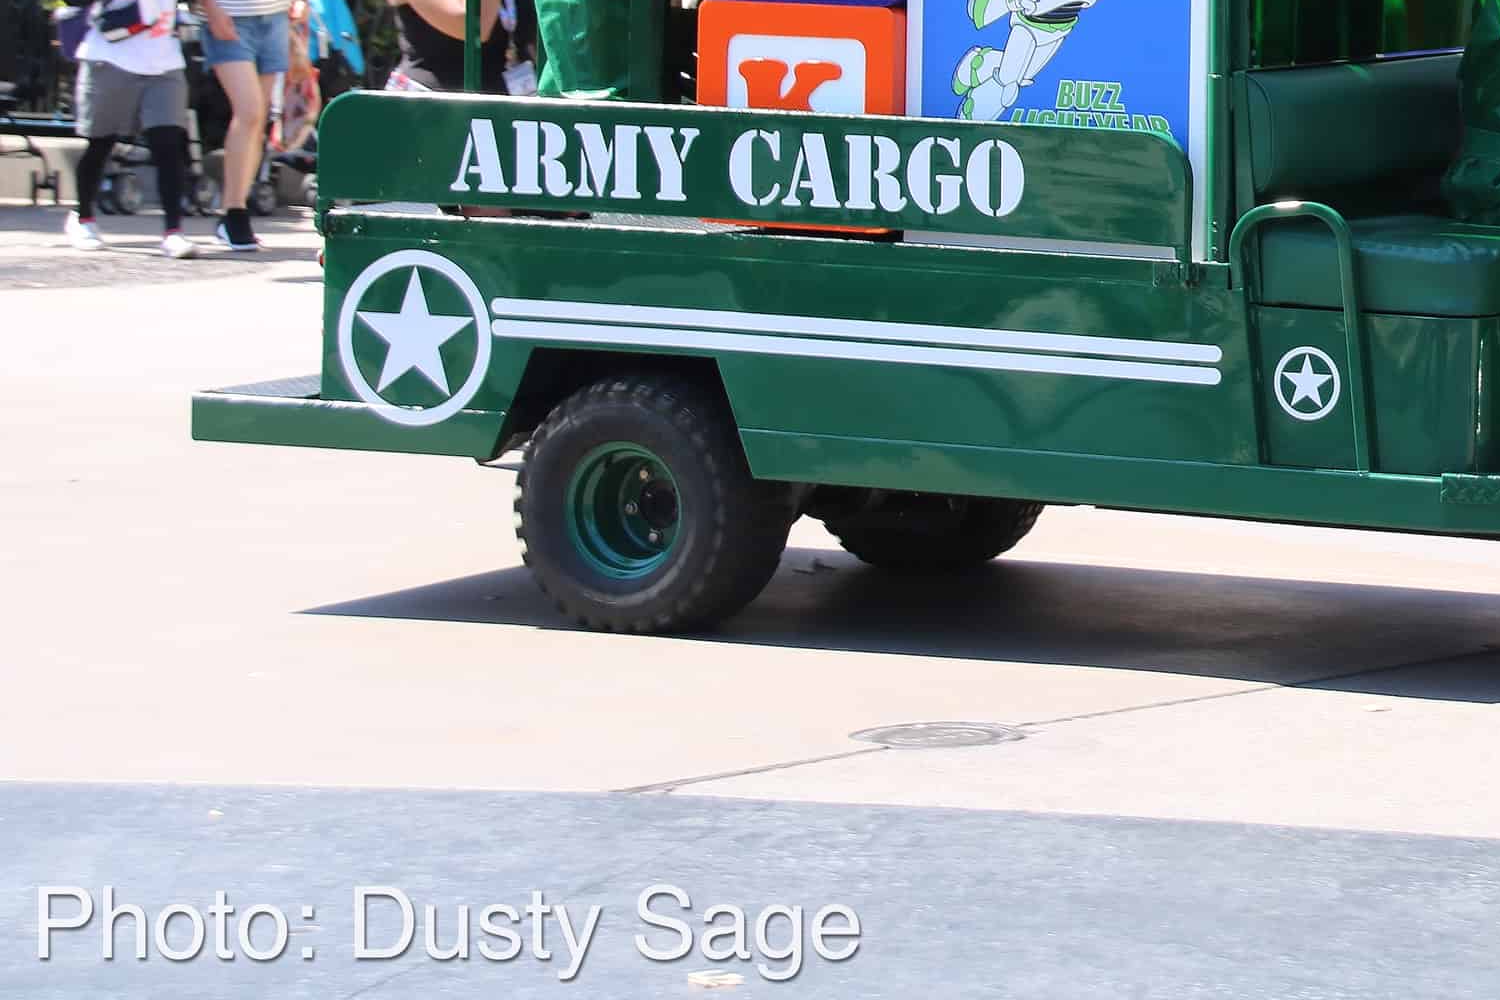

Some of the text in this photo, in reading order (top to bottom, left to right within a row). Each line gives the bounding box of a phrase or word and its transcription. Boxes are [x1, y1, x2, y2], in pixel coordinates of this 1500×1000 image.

[1055, 79, 1125, 112] BUZZ
[450, 118, 1026, 217] ARMY CARGO
